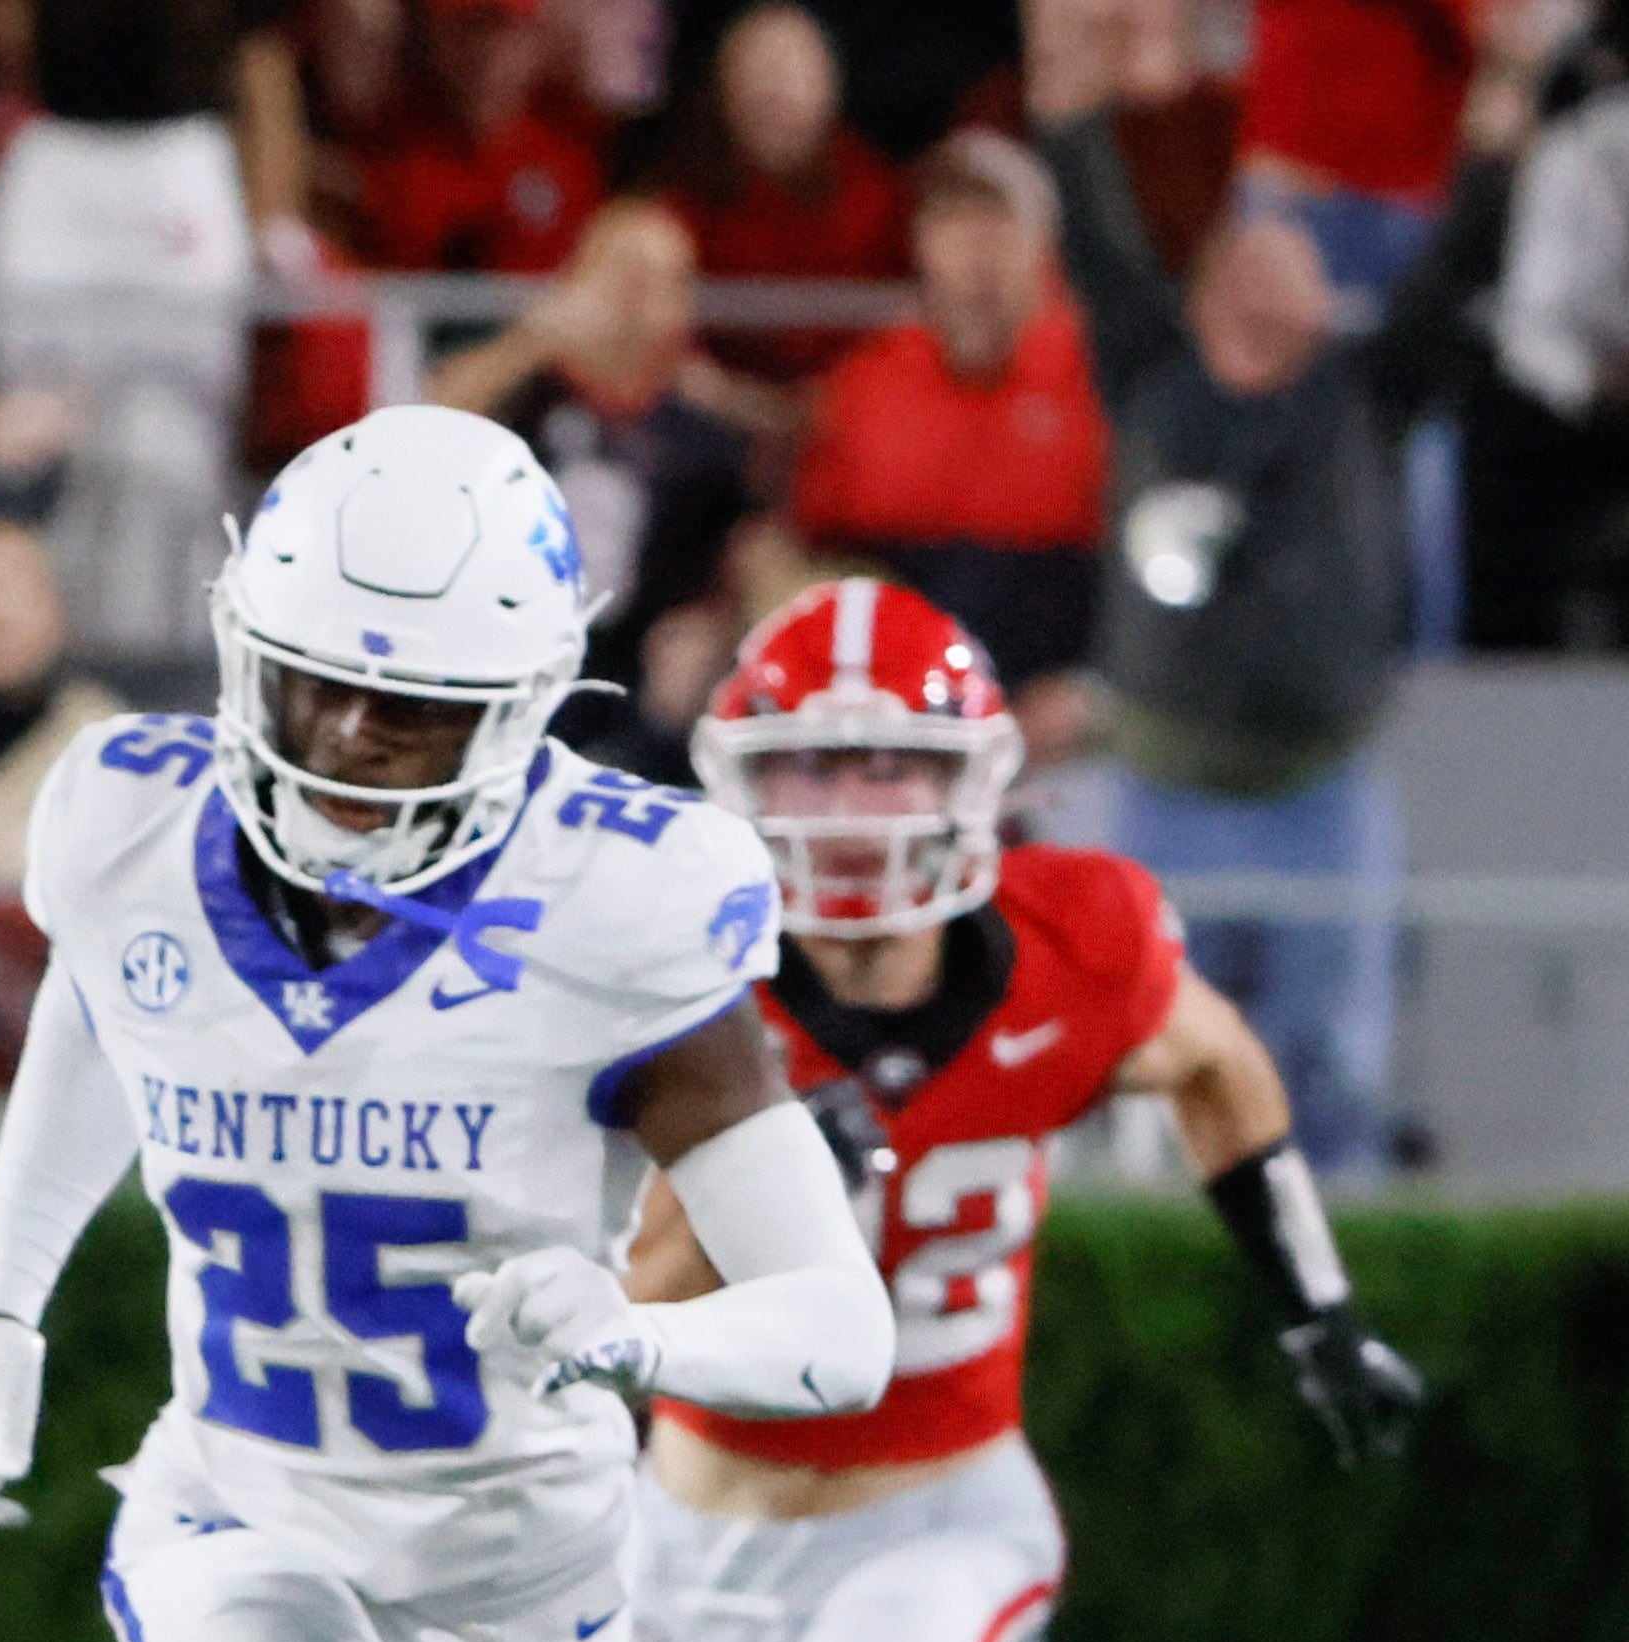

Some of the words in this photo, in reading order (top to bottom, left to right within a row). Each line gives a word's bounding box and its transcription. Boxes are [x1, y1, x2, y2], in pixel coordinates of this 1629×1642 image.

[142, 1074, 496, 1171] KENTUCKY
[163, 1173, 489, 1453] 25
[847, 1136, 1035, 1378] 2
